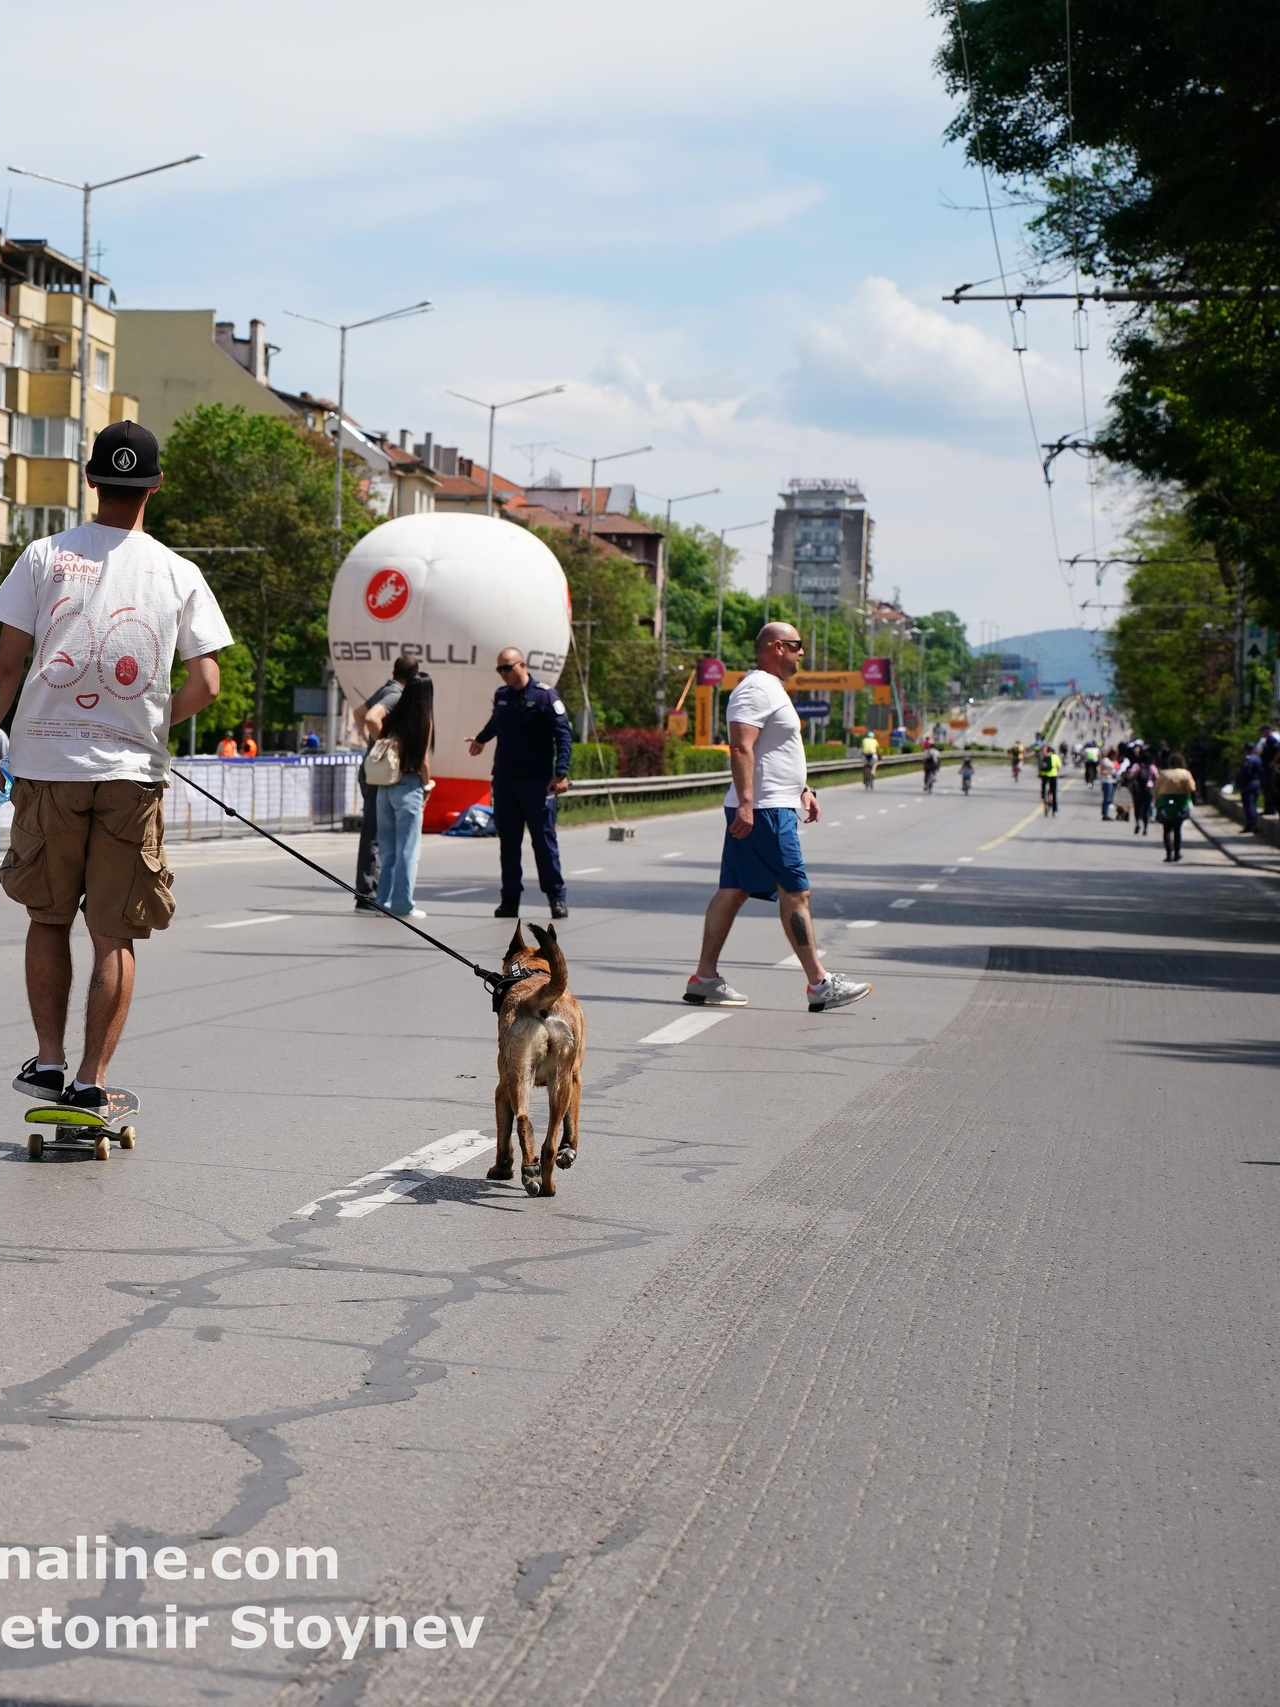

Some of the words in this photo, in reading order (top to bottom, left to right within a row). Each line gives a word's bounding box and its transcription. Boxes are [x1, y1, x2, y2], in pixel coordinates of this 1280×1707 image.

[54, 553, 83, 563] HOT
[53, 564, 98, 575] DAMN!
[53, 574, 102, 587] COFFEE
